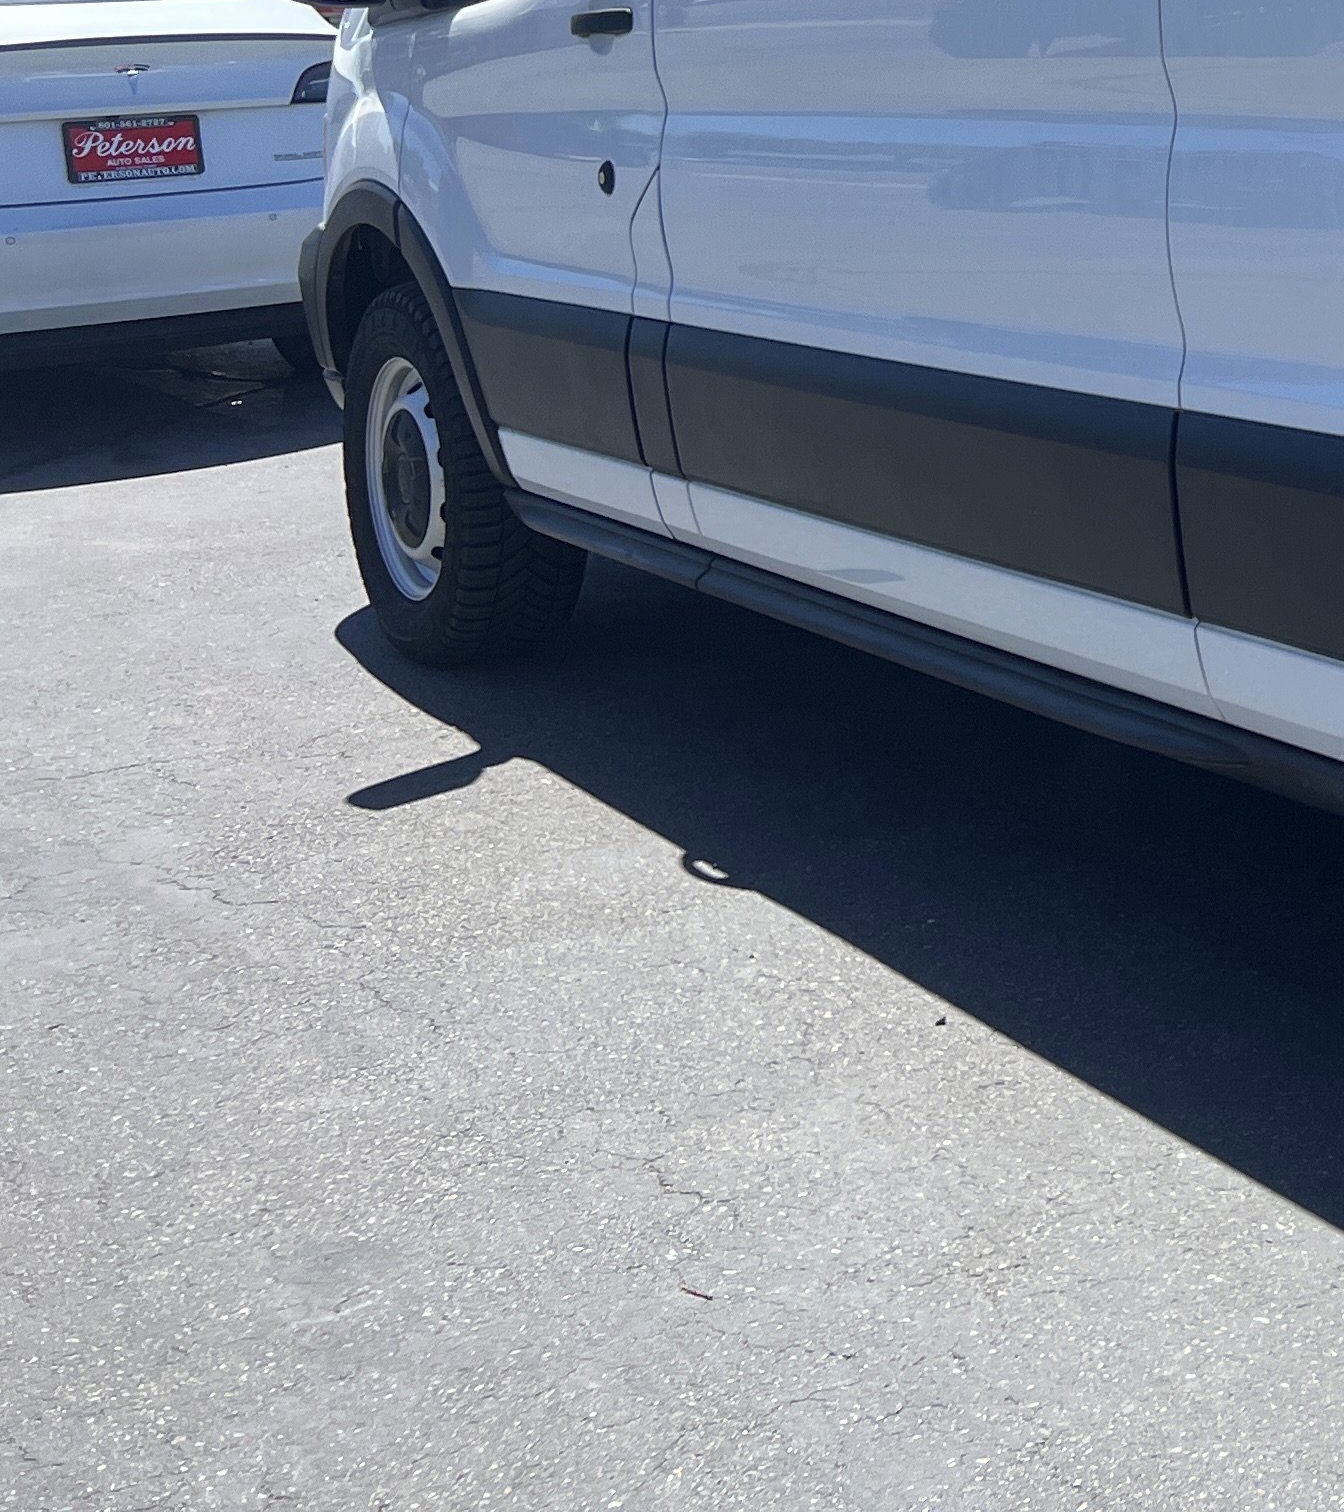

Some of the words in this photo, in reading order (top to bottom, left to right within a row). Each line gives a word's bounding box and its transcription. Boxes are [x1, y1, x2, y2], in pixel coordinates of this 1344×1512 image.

[72, 131, 197, 158] Peterson
[107, 157, 132, 167] AUTO
[134, 155, 166, 166] SALES
[80, 163, 197, 182] PEERSONAUTO.COM
